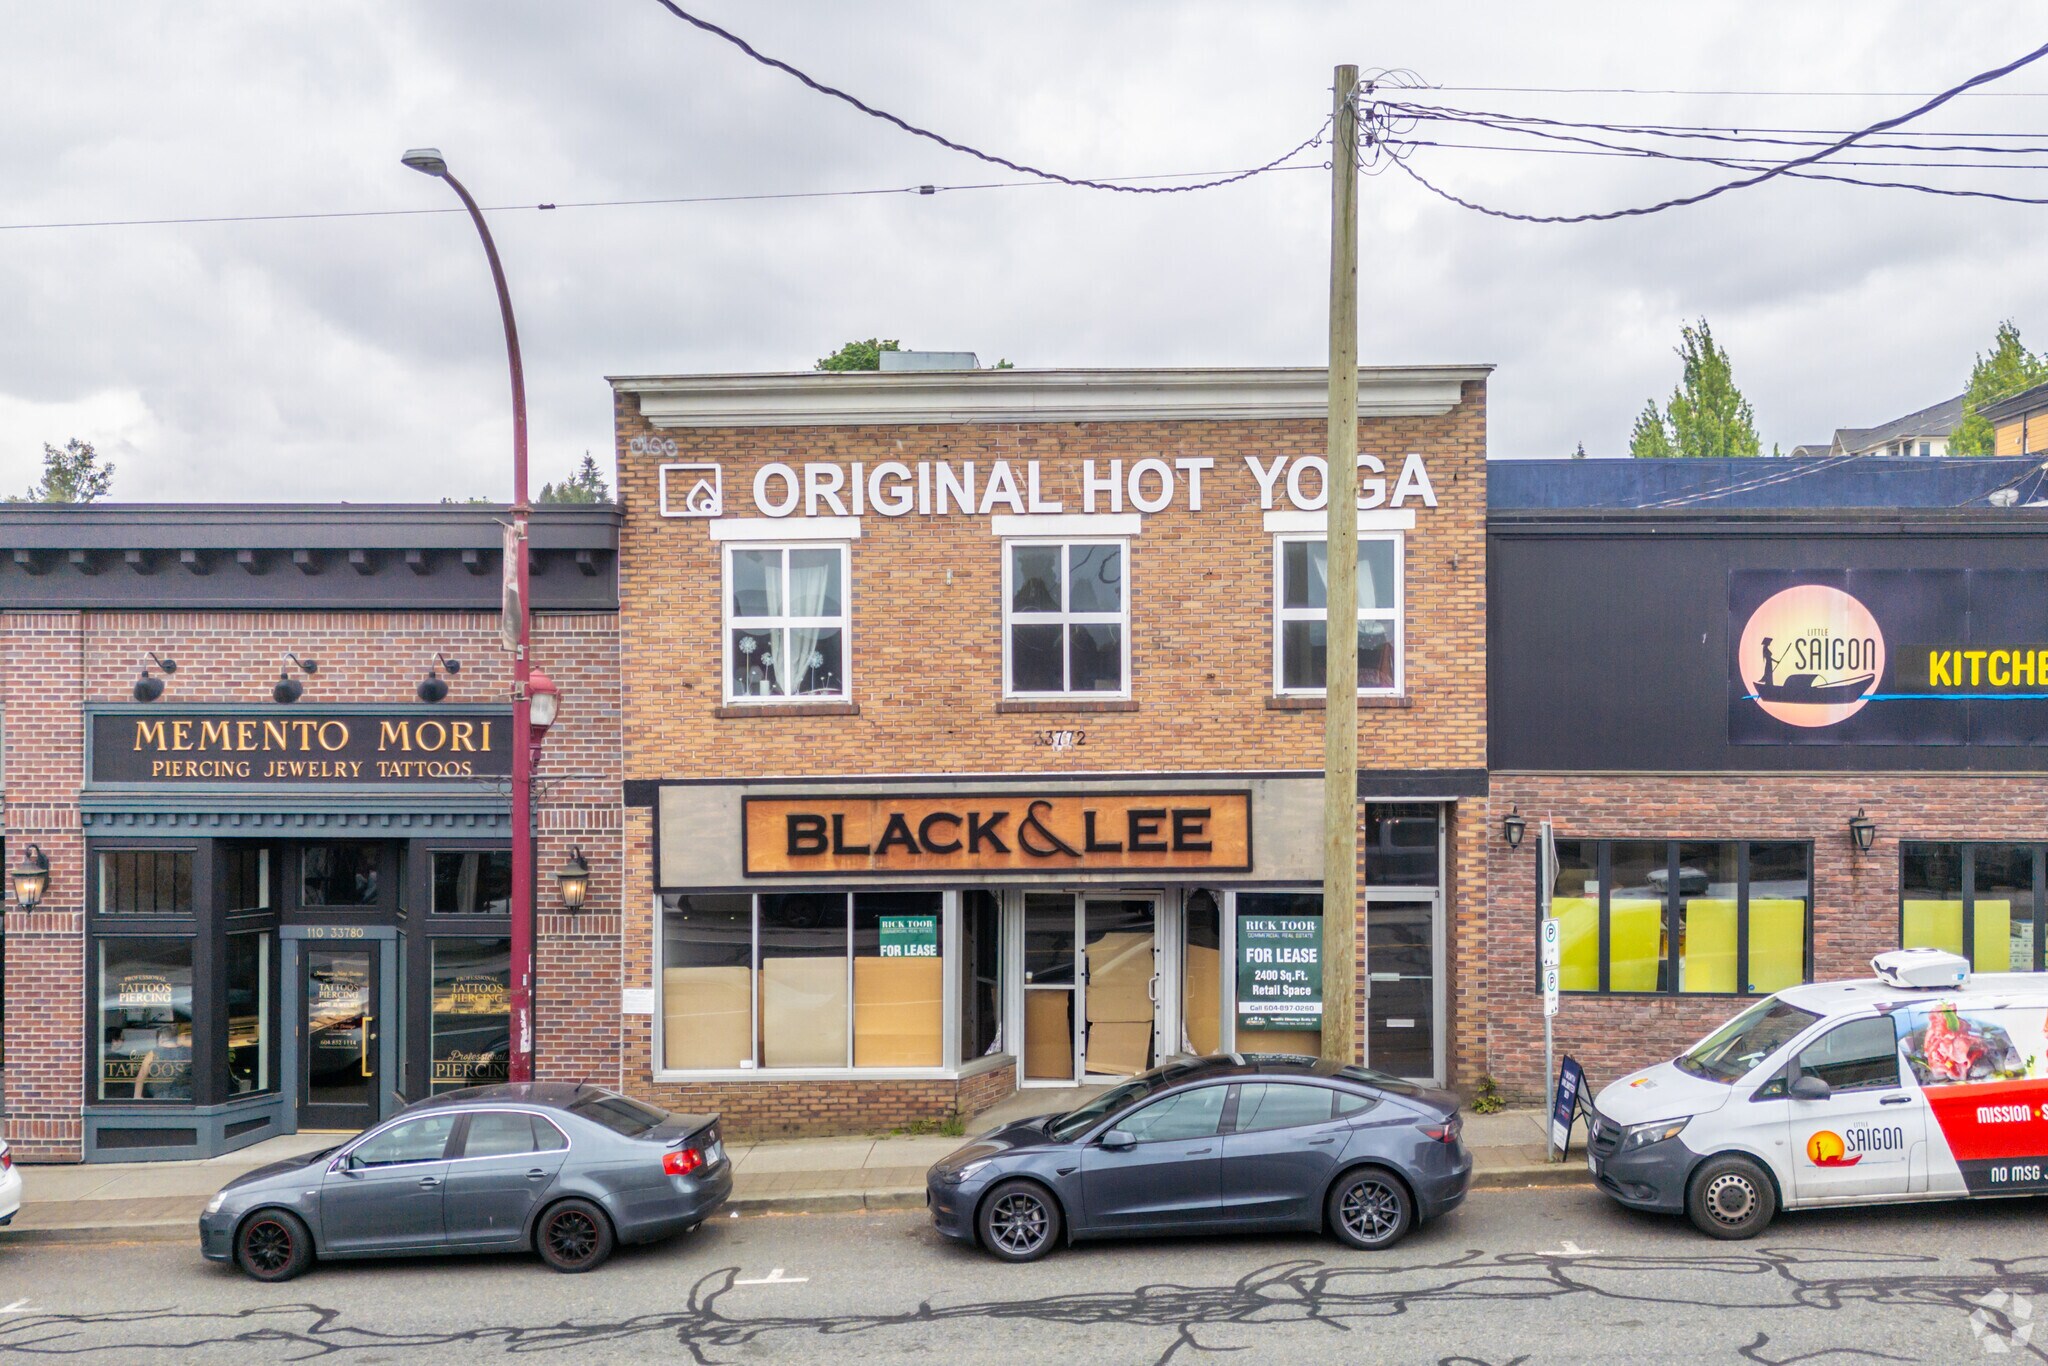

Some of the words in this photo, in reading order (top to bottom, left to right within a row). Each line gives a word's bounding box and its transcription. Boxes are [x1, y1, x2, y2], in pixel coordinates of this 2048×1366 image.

[752, 460, 1062, 517] ORIGINAL
[1084, 457, 1214, 513] HOT
[1244, 453, 1438, 511] YOGA
[1807, 628, 1829, 637] LITTLE
[1795, 638, 1876, 671] SAIGON
[133, 720, 349, 752] MEMENTO
[377, 720, 491, 752] MORI
[1034, 731, 1086, 746] 33772
[151, 761, 251, 778] PIERCING
[264, 761, 364, 778] JEWELRY
[376, 761, 473, 778] TATTOOS
[907, 920, 933, 928] TOOR
[1246, 920, 1277, 930] RICK
[1280, 920, 1315, 930] TOOR
[307, 928, 324, 938] 110
[330, 928, 364, 938] 33780
[880, 945, 902, 957] FOR
[904, 944, 937, 957] LEASE
[1246, 948, 1272, 963] FOR
[1276, 948, 1317, 963] LEASE
[1255, 970, 1278, 981] 2400
[1280, 970, 1308, 983] Sq.Ft.
[119, 983, 172, 993] TATTOOS
[319, 984, 359, 992] TATTOOS
[451, 983, 504, 993] TATTOOS
[1252, 985, 1280, 996] Retail
[1282, 985, 1311, 998] Space
[119, 993, 171, 1003] PIERCING
[319, 991, 359, 999] PIERCING
[451, 993, 503, 1003] PIERCING
[106, 1063, 184, 1078] TATOOS
[436, 1063, 510, 1078] PIERCIN
[1846, 1127, 1903, 1151] SAIGON
[2012, 1165, 2040, 1182] MSG
